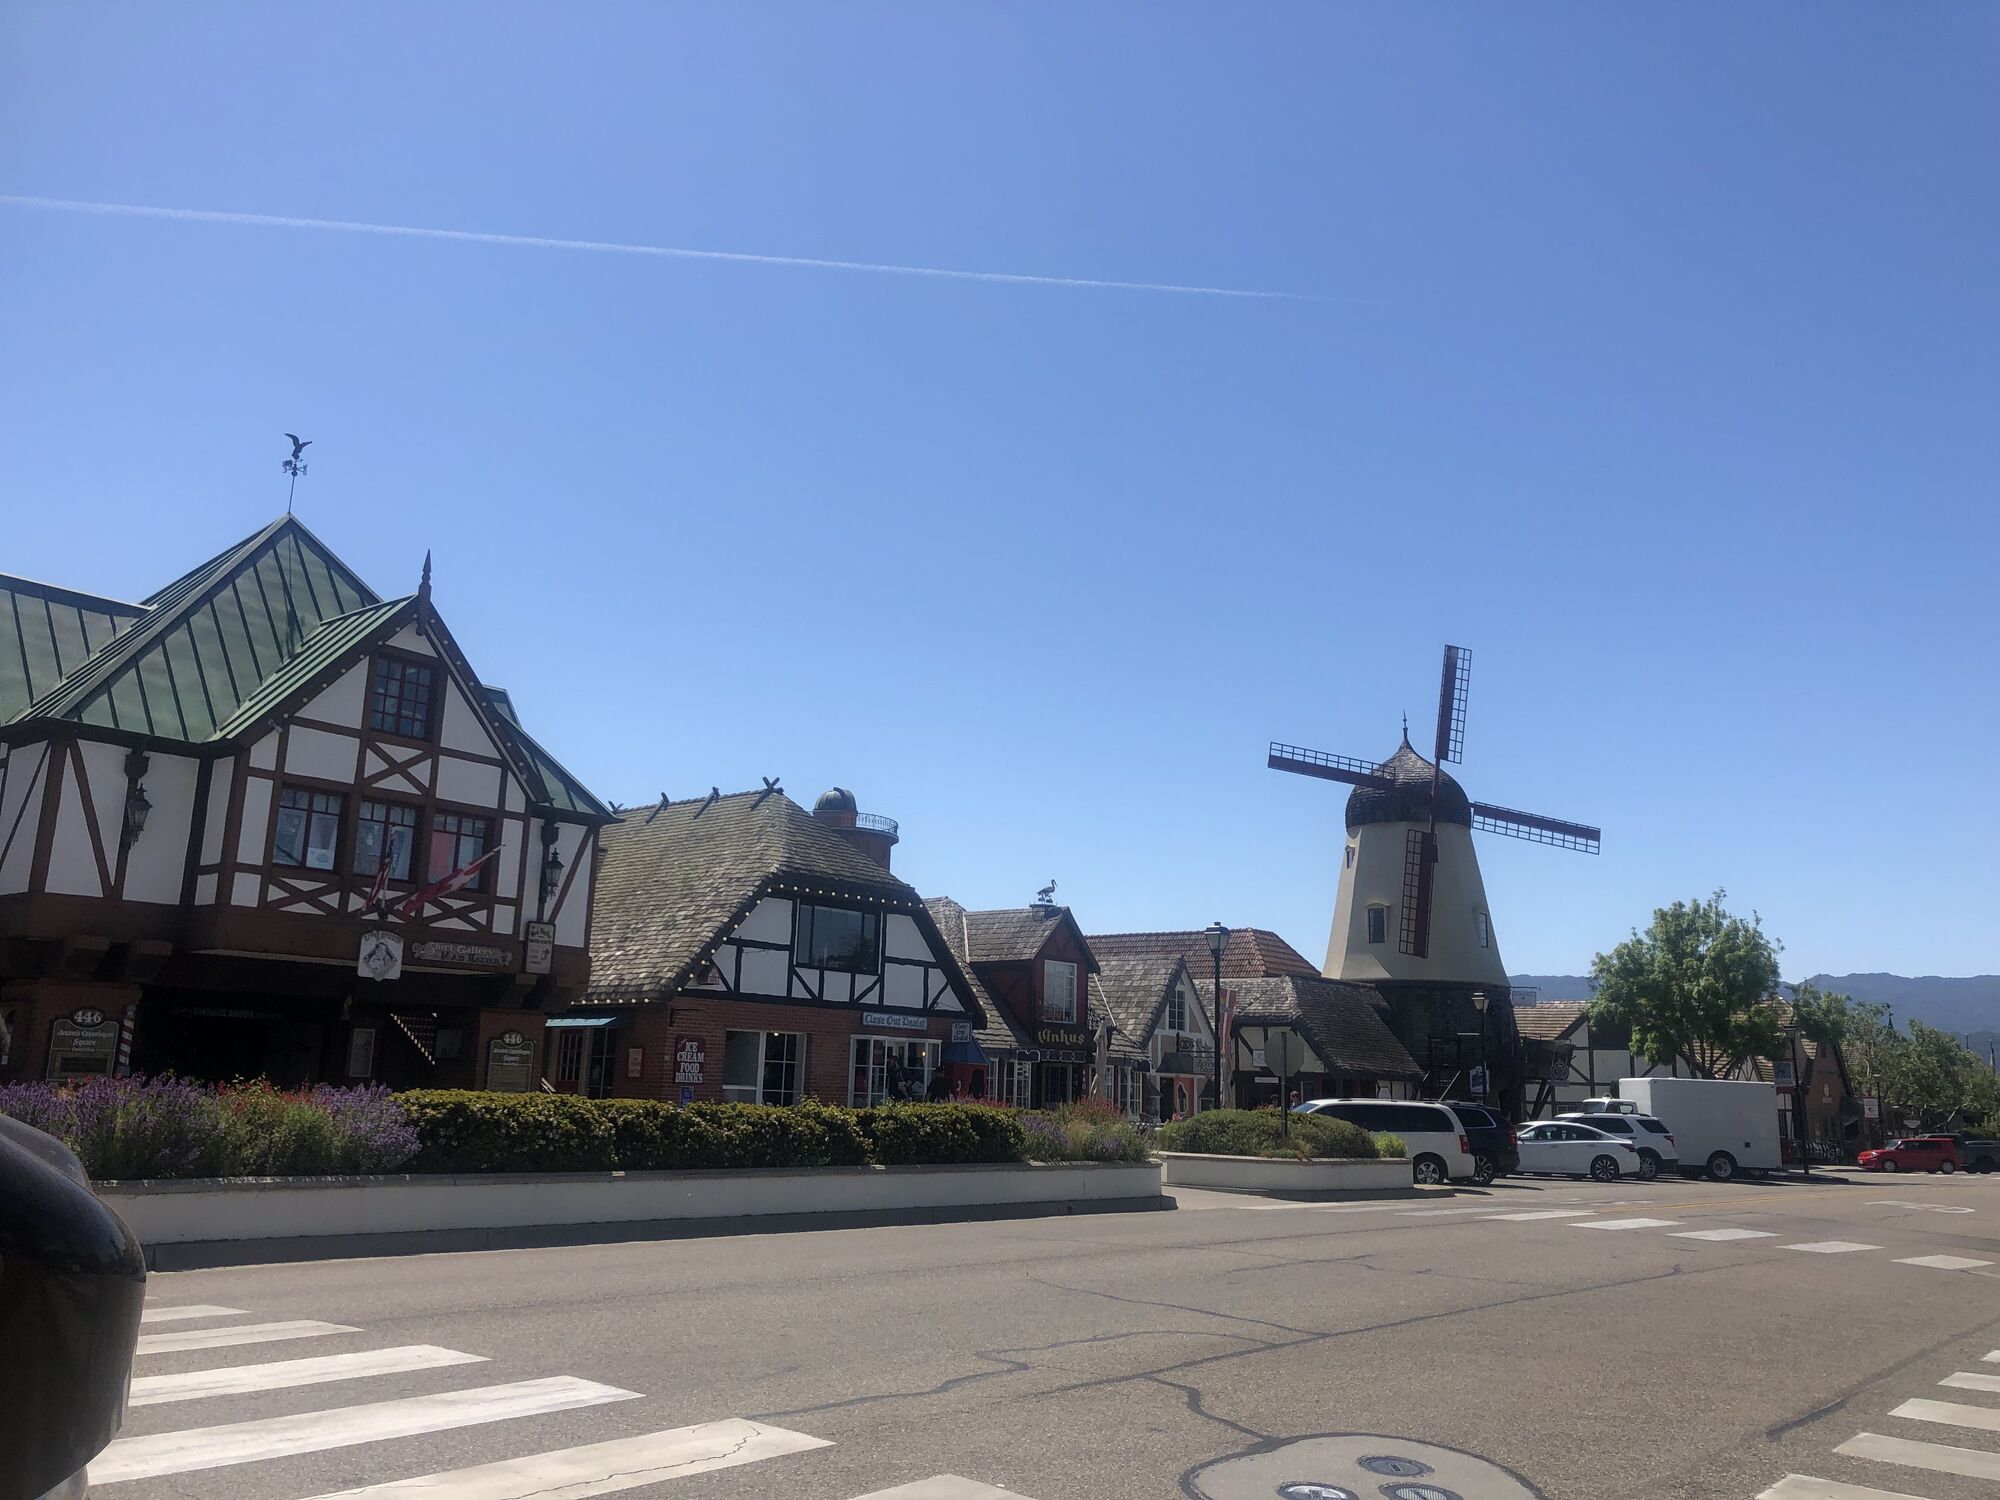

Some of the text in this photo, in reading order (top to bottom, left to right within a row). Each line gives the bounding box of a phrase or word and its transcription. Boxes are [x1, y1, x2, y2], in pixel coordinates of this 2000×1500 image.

[74, 1010, 102, 1023] 446
[865, 1014, 885, 1025] Close
[886, 1016, 901, 1026] Out
[503, 1034, 523, 1044] 446
[1037, 1028, 1086, 1045] Vinhus
[685, 1041, 698, 1052] ICE
[676, 1052, 705, 1063] CREAM
[680, 1062, 700, 1073] FOOD
[674, 1072, 704, 1084] DRINKS
